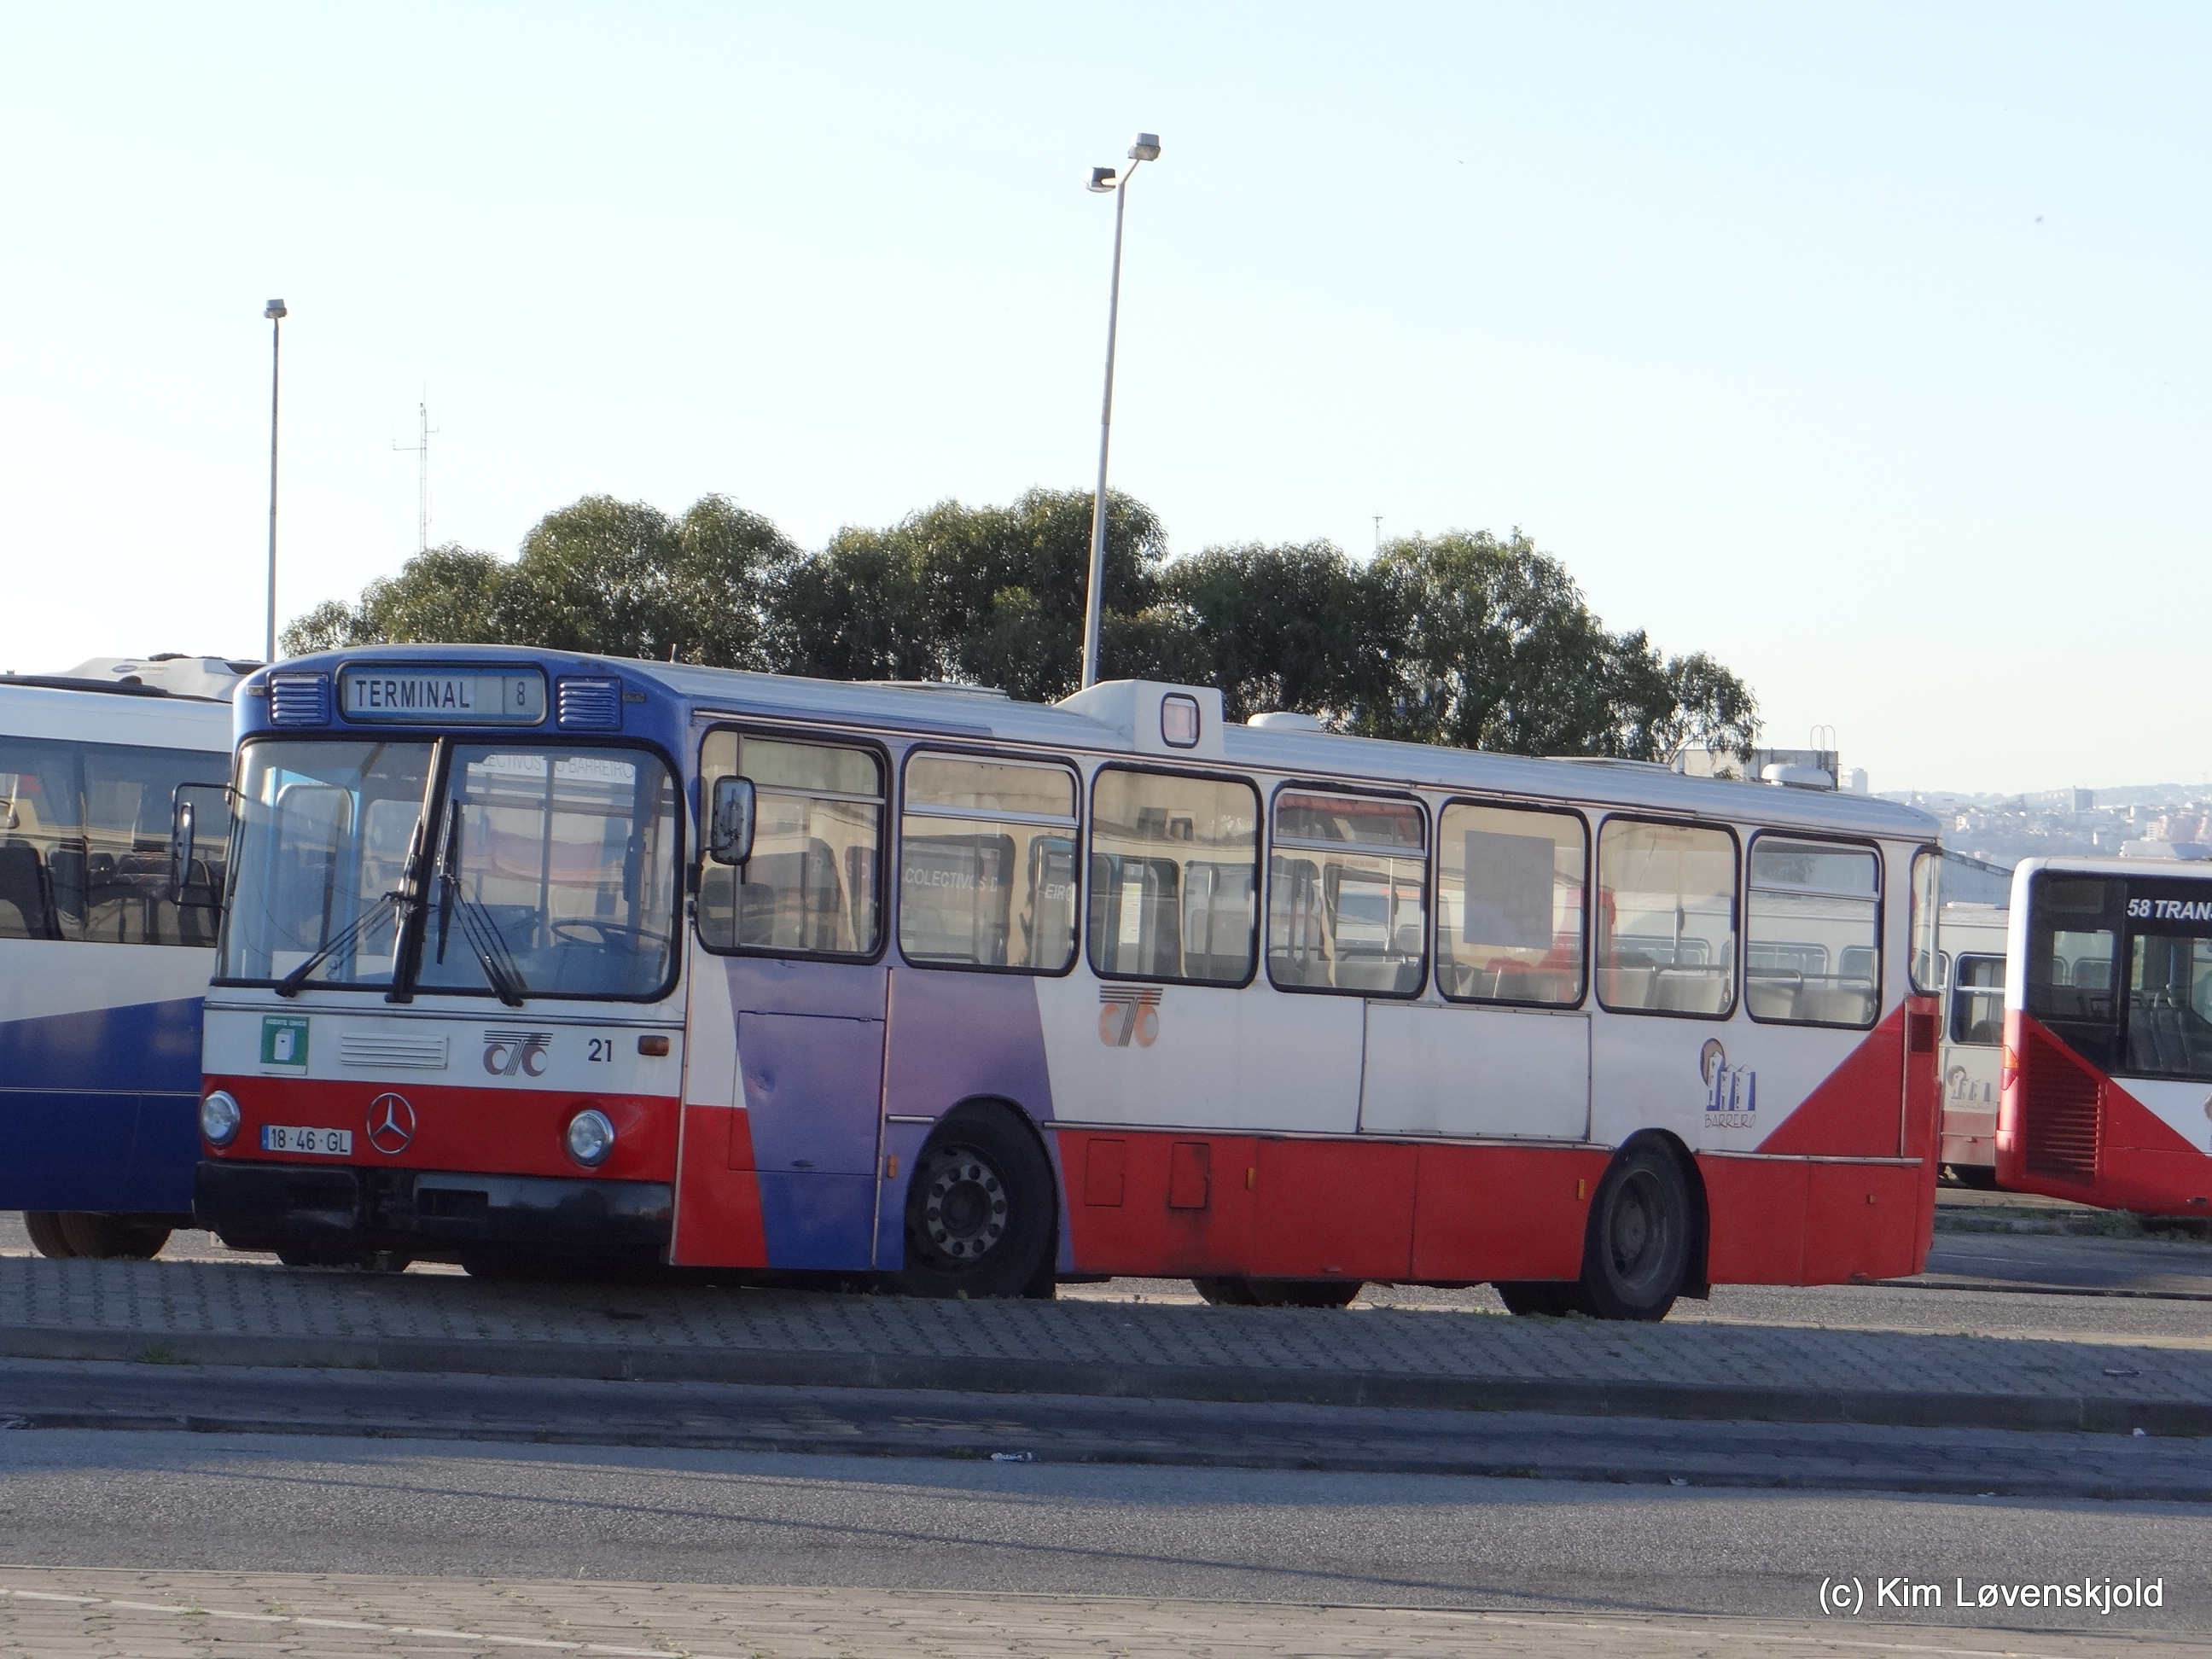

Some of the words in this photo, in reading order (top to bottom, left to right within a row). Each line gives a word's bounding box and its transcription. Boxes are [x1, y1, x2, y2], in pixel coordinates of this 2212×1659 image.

[355, 679, 470, 708] TERMINAL
[516, 681, 527, 706] 8
[2127, 899, 2151, 917] 58
[2155, 899, 2212, 920] TRAN
[588, 1038, 612, 1062] 21
